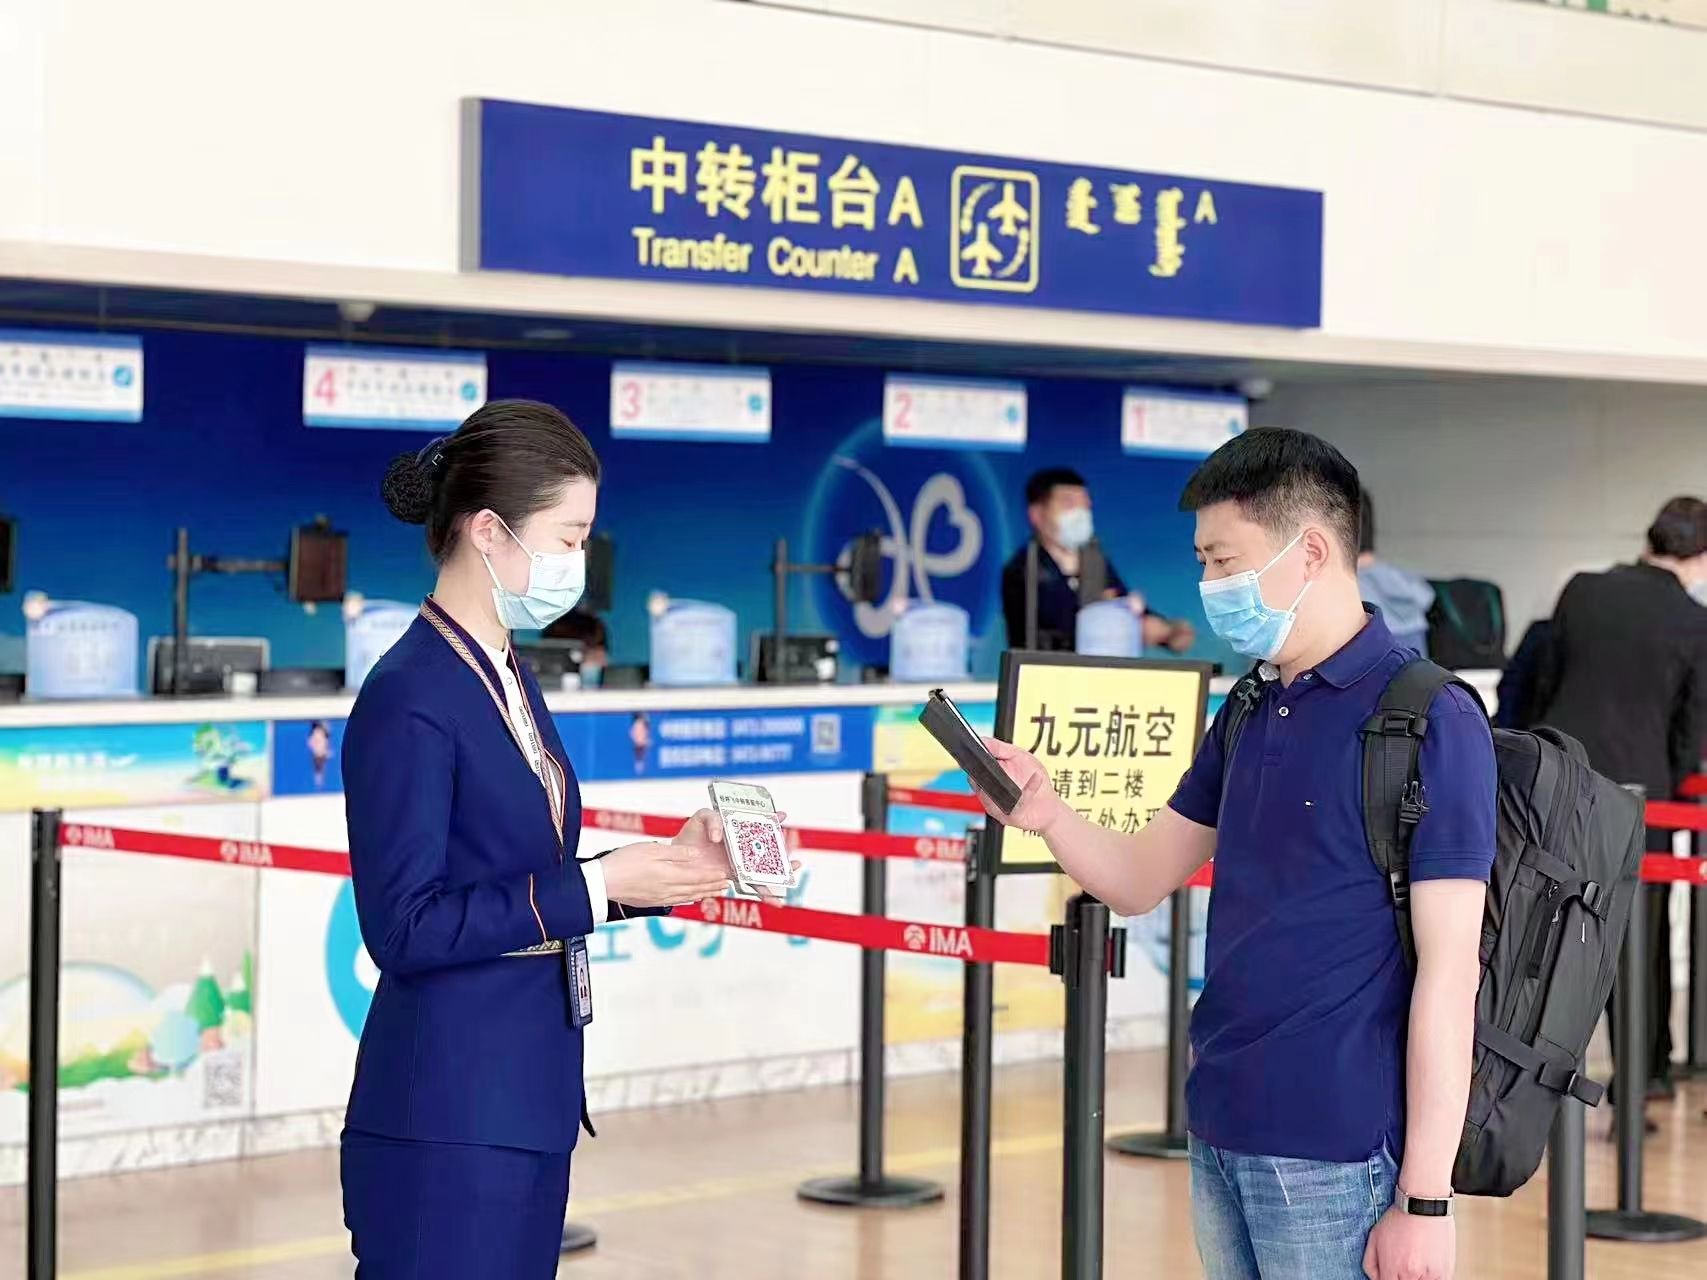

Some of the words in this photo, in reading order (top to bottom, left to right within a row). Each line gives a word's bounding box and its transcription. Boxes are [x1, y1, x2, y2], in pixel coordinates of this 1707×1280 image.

[1193, 188, 1218, 226] A
[631, 226, 753, 273] Transfer
[767, 235, 880, 281] Counter
[892, 247, 920, 285] A
[314, 367, 338, 406] 4
[620, 379, 643, 420] 3
[892, 390, 913, 430] 2
[1132, 404, 1147, 440] 1
[1028, 703, 1176, 758] 九元航空
[1052, 768, 1145, 800] 请到二楼
[723, 902, 762, 929] IMA
[928, 926, 974, 957] IMA
